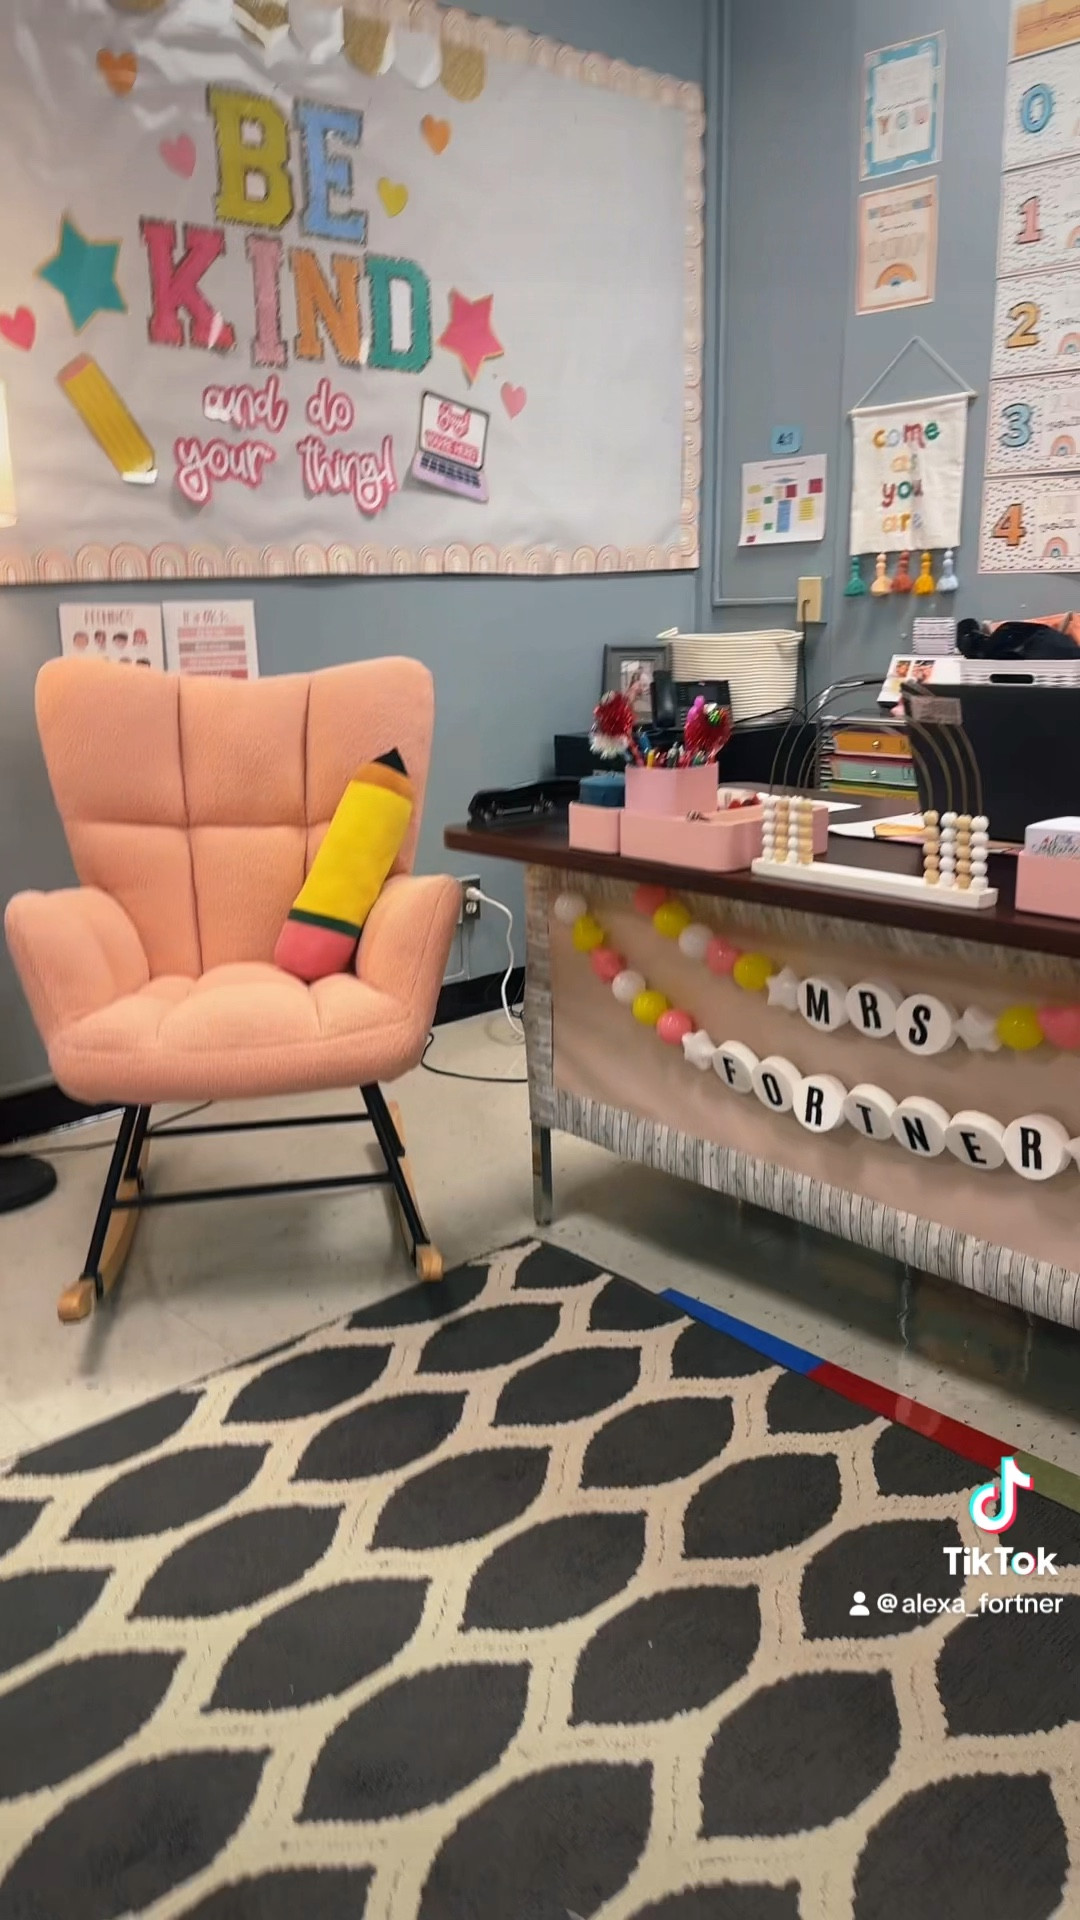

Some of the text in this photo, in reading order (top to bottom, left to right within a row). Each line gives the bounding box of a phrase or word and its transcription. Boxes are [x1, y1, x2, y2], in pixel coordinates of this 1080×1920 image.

[1020, 83, 1054, 134] 0
[206, 82, 367, 247] BE
[1015, 195, 1042, 245] 1
[139, 215, 432, 374] KIND
[1005, 301, 1040, 349] 2
[203, 374, 354, 434] and do
[1000, 402, 1033, 448] 3
[872, 422, 941, 449] come
[174, 436, 277, 507] your
[296, 434, 398, 514] thing!
[891, 453, 918, 474] as
[882, 479, 924, 508] you
[882, 512, 924, 533] are
[992, 502, 1027, 548] 4
[805, 982, 932, 1046] MRS
[721, 1056, 1043, 1171] FORTNER
